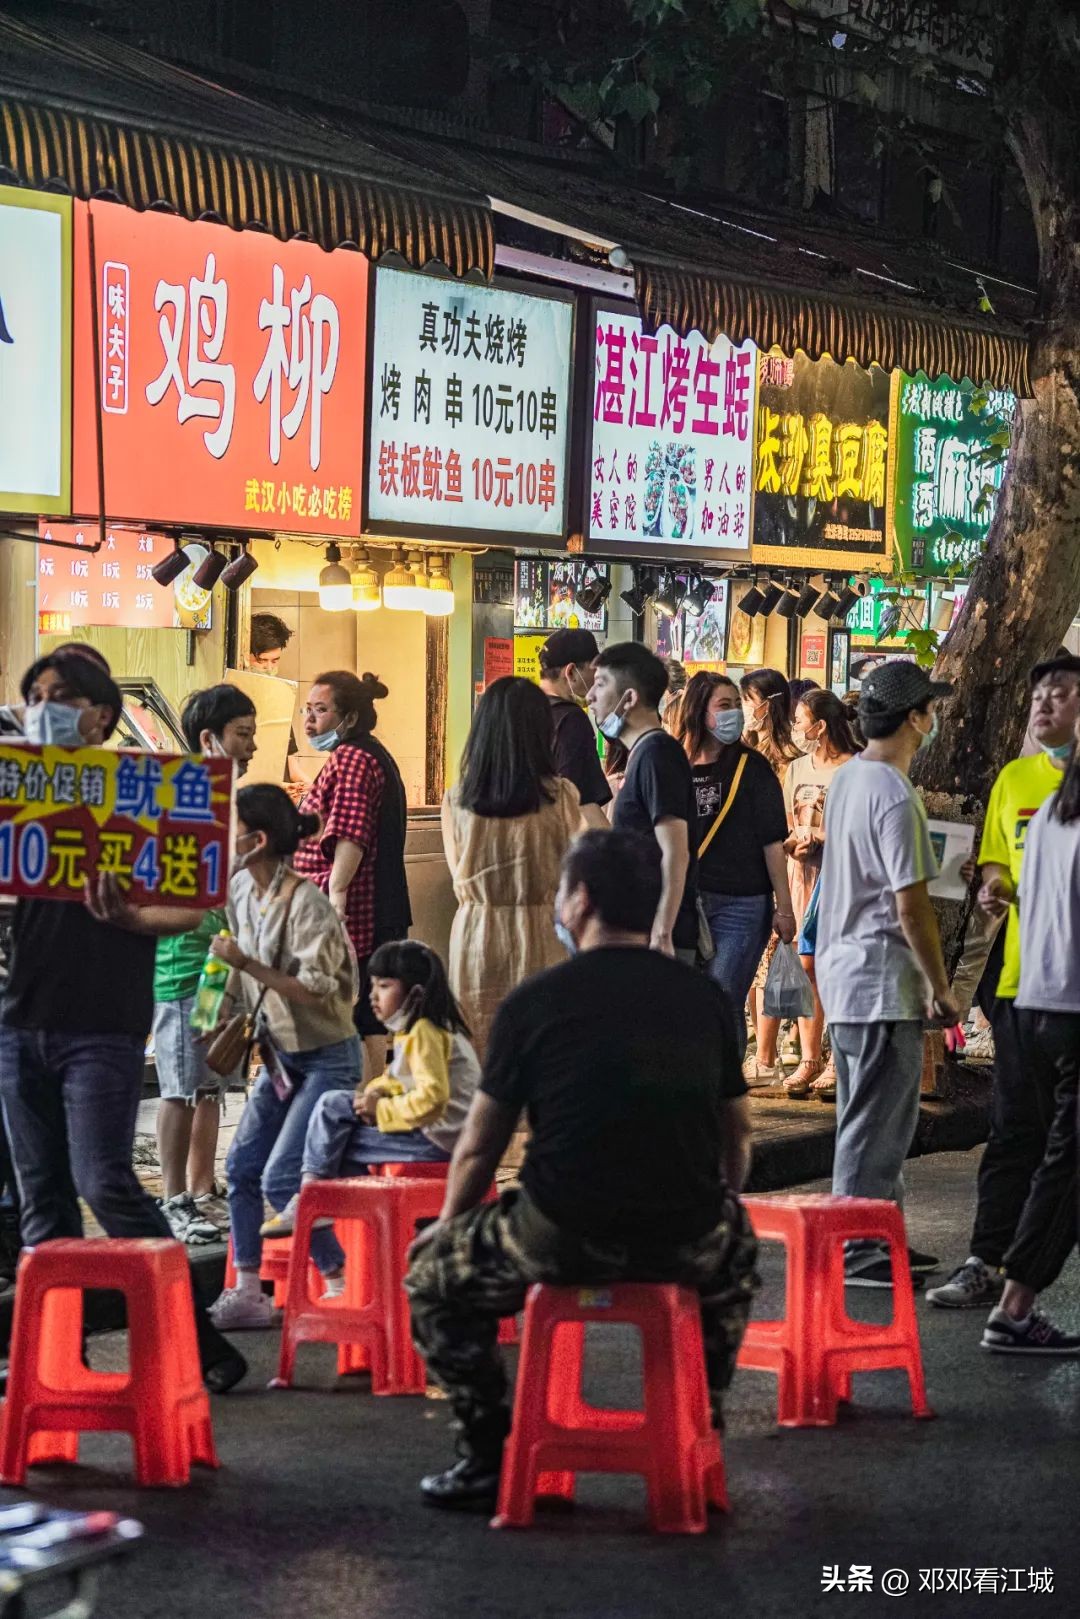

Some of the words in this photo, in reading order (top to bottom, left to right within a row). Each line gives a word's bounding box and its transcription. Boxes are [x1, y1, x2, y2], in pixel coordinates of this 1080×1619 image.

[107, 283, 126, 400] 味夫子
[418, 301, 528, 368] 真功夫烧烤
[145, 252, 340, 472] 鸡柳
[593, 323, 751, 442] 湛江烤生蚝
[379, 362, 463, 429] 烤肉串
[472, 383, 557, 441] 10元10串
[377, 440, 464, 503] 铁板鱿鱼
[471, 457, 556, 513] 10元10串
[594, 445, 638, 484] 女人的
[704, 458, 746, 495] 男人的
[245, 478, 353, 521] 武汉小吃必吃榜
[591, 490, 637, 531] 美容院
[701, 502, 745, 538] 加油站
[107, 534, 116, 550] 大
[71, 560, 88, 577] 10元
[102, 562, 120, 579] 15元
[70, 591, 88, 608] 10元
[102, 592, 120, 609] 15元
[0, 757, 105, 805] 特价促销
[115, 754, 215, 822] 鱿鱼
